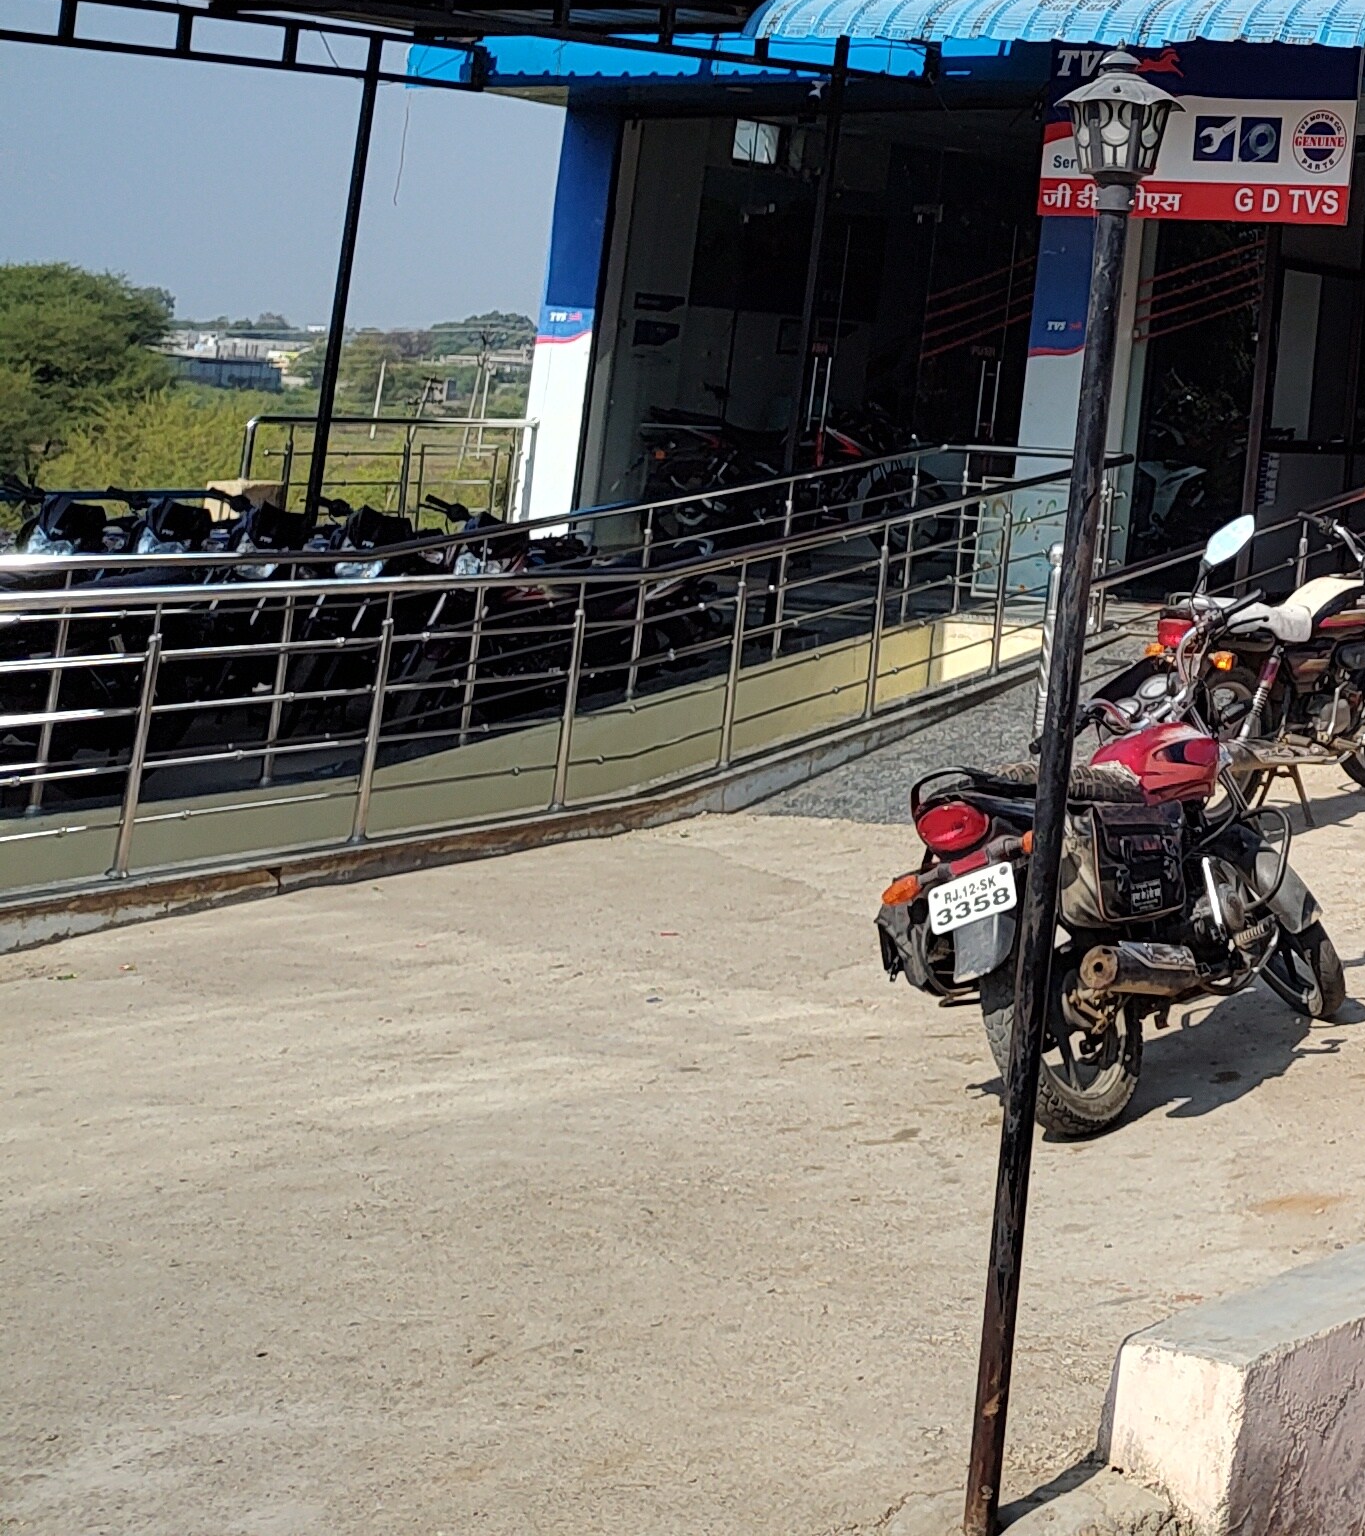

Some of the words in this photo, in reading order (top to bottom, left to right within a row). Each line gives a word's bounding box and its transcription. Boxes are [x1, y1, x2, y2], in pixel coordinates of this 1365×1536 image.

[1057, 49, 1103, 77] TV
[1310, 113, 1334, 122] MOTOR
[1295, 136, 1345, 147] GENUINE
[1301, 158, 1334, 170] PARTS
[1043, 183, 1072, 208] जी
[1234, 187, 1254, 212] G
[1262, 188, 1280, 213] D
[1288, 189, 1339, 215] TVS
[1047, 320, 1067, 331] TVS
[936, 887, 1011, 926] 3358
